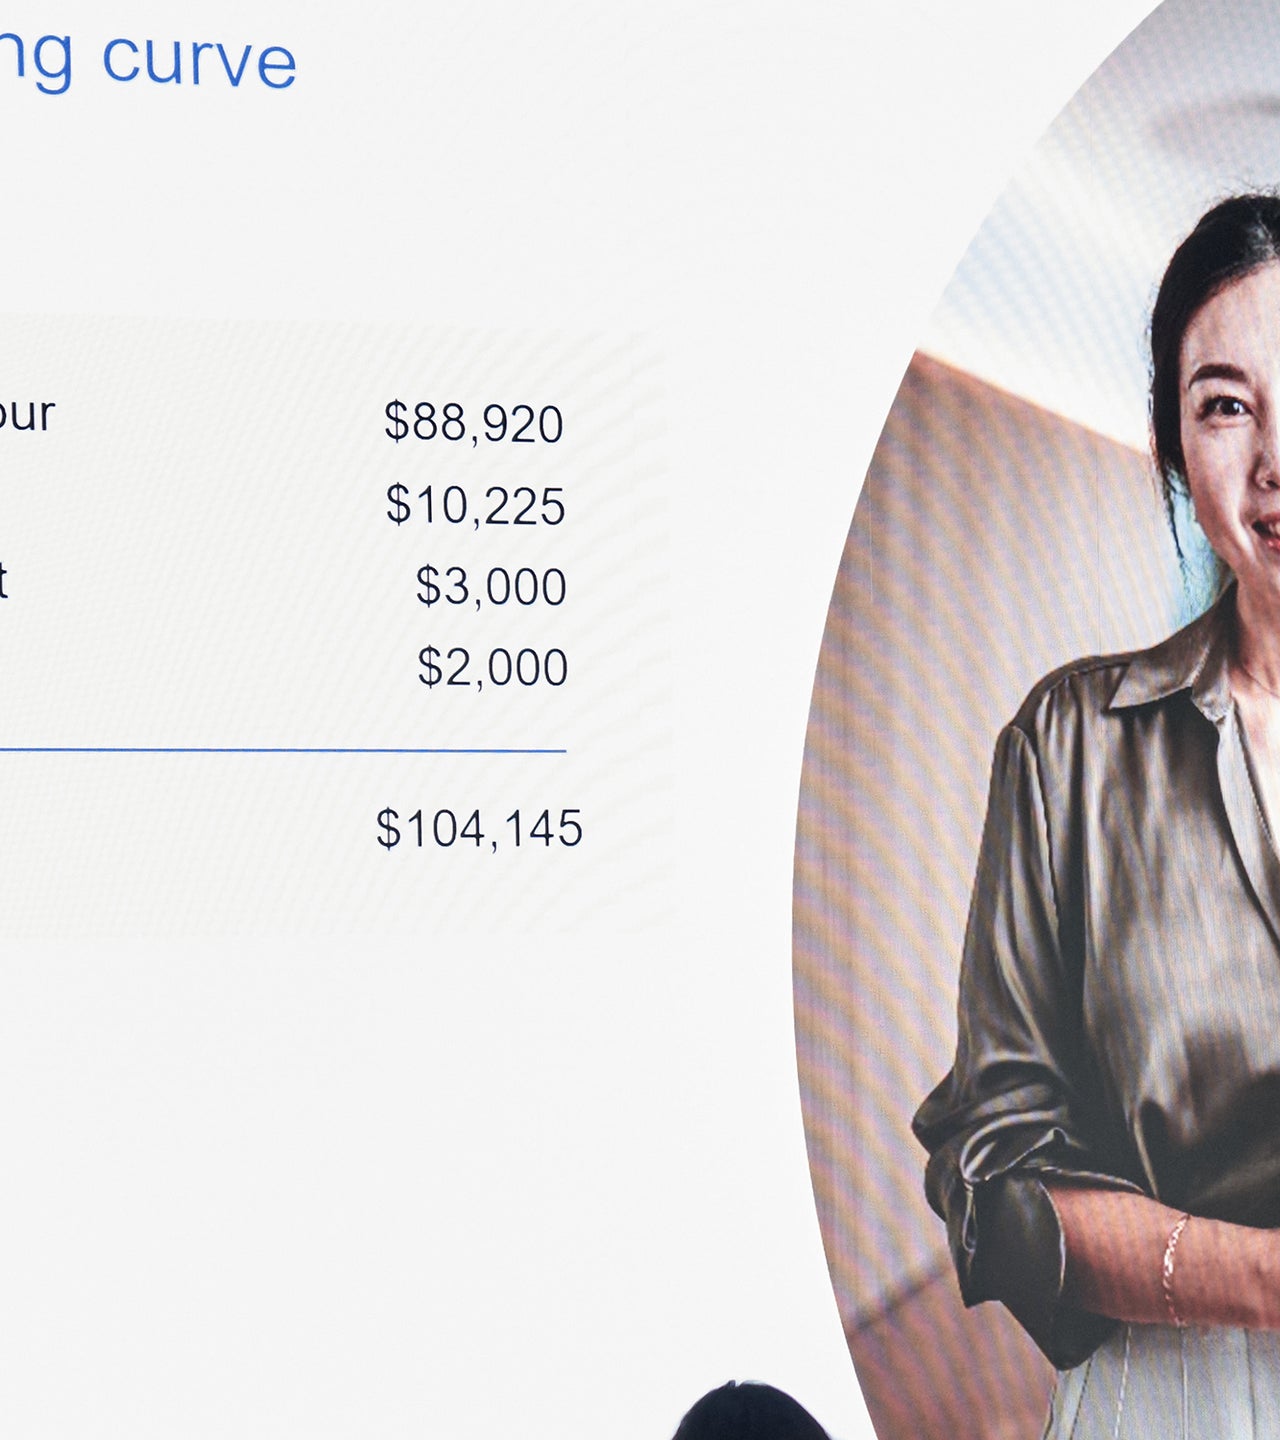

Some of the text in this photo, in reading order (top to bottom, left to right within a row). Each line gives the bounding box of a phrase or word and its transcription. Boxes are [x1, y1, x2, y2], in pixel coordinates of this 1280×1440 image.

[0, 33, 297, 95] ng curve
[0, 401, 56, 431] ur
[384, 398, 564, 449] $88,920
[386, 481, 566, 531] $10,225
[416, 563, 567, 612] $3,000
[418, 644, 569, 693] $2,000
[376, 806, 583, 854] $104,145
